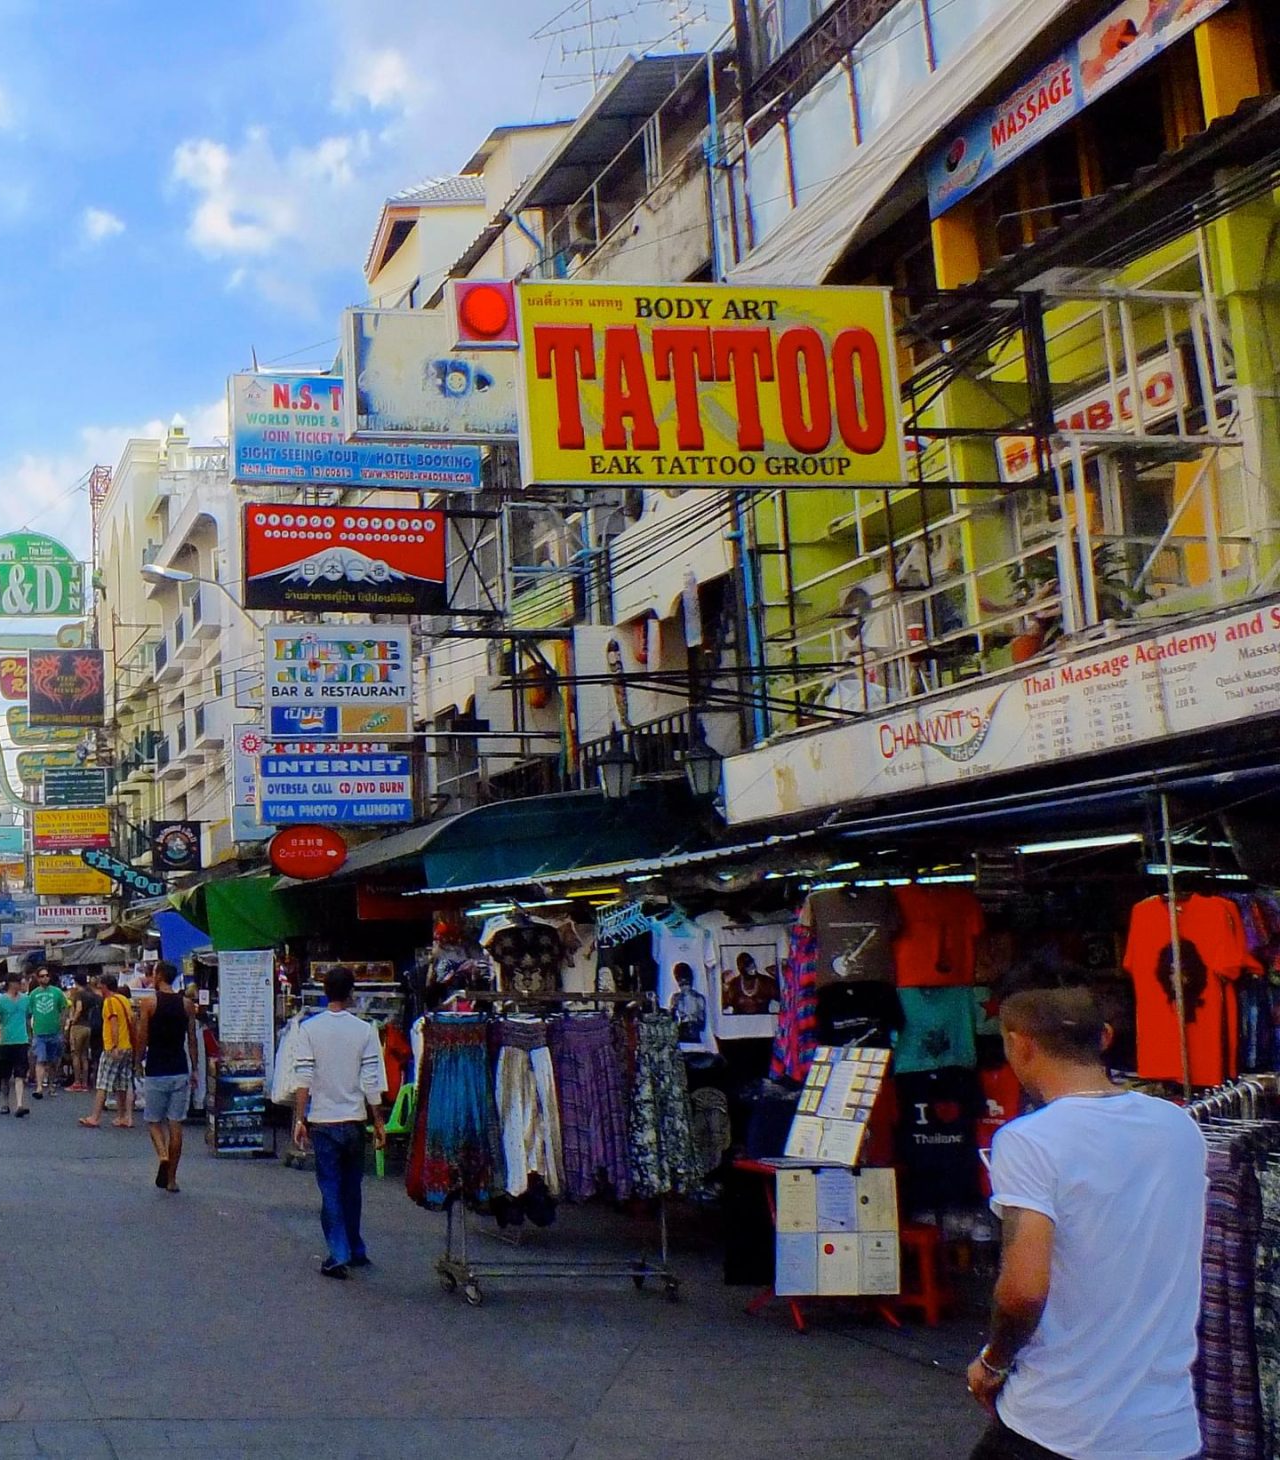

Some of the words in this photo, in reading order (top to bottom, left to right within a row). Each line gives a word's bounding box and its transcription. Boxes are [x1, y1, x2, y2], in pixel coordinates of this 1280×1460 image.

[991, 68, 1073, 151] MASSAGE
[635, 297, 712, 319] BODY
[722, 299, 779, 321] ART
[273, 383, 320, 411] N.S.
[534, 323, 887, 455] TATTOO
[246, 413, 289, 426] WORLD
[296, 414, 325, 427] WIDE
[330, 416, 340, 427] &
[262, 430, 290, 443] JOIN
[295, 431, 332, 444] TICKET
[242, 447, 276, 460] SIGHT
[281, 449, 322, 462] SEEING
[328, 450, 359, 463] TOUR
[376, 452, 413, 466] HOTEL
[416, 454, 473, 468] BOOKING
[590, 455, 641, 475] EAK
[651, 455, 756, 475] TATTOO
[765, 456, 851, 477] GROUP
[256, 514, 334, 528] NIPPON
[345, 518, 435, 531] ICHIBAN
[69, 565, 81, 611] INN
[1024, 671, 1056, 696] Thai
[1060, 653, 1129, 686] Massage
[1135, 630, 1217, 664] Academy
[1225, 613, 1263, 641] and
[1160, 661, 1198, 676] Massage
[272, 686, 298, 697] BAR
[304, 686, 314, 697] &
[321, 686, 407, 697] RESTAURANT
[268, 760, 402, 773] INTERNET
[267, 783, 308, 794] OVERSEA
[312, 783, 333, 794] CALL
[339, 782, 376, 794] CD/DVD
[380, 781, 404, 793] BURN
[269, 805, 294, 817] VISA
[299, 805, 337, 817] PHOTO
[353, 804, 405, 816] LAUNDRY
[84, 851, 163, 896] TATTOO
[38, 906, 82, 917] INTERNET
[85, 906, 108, 916] CAFE
[915, 1103, 928, 1125] I
